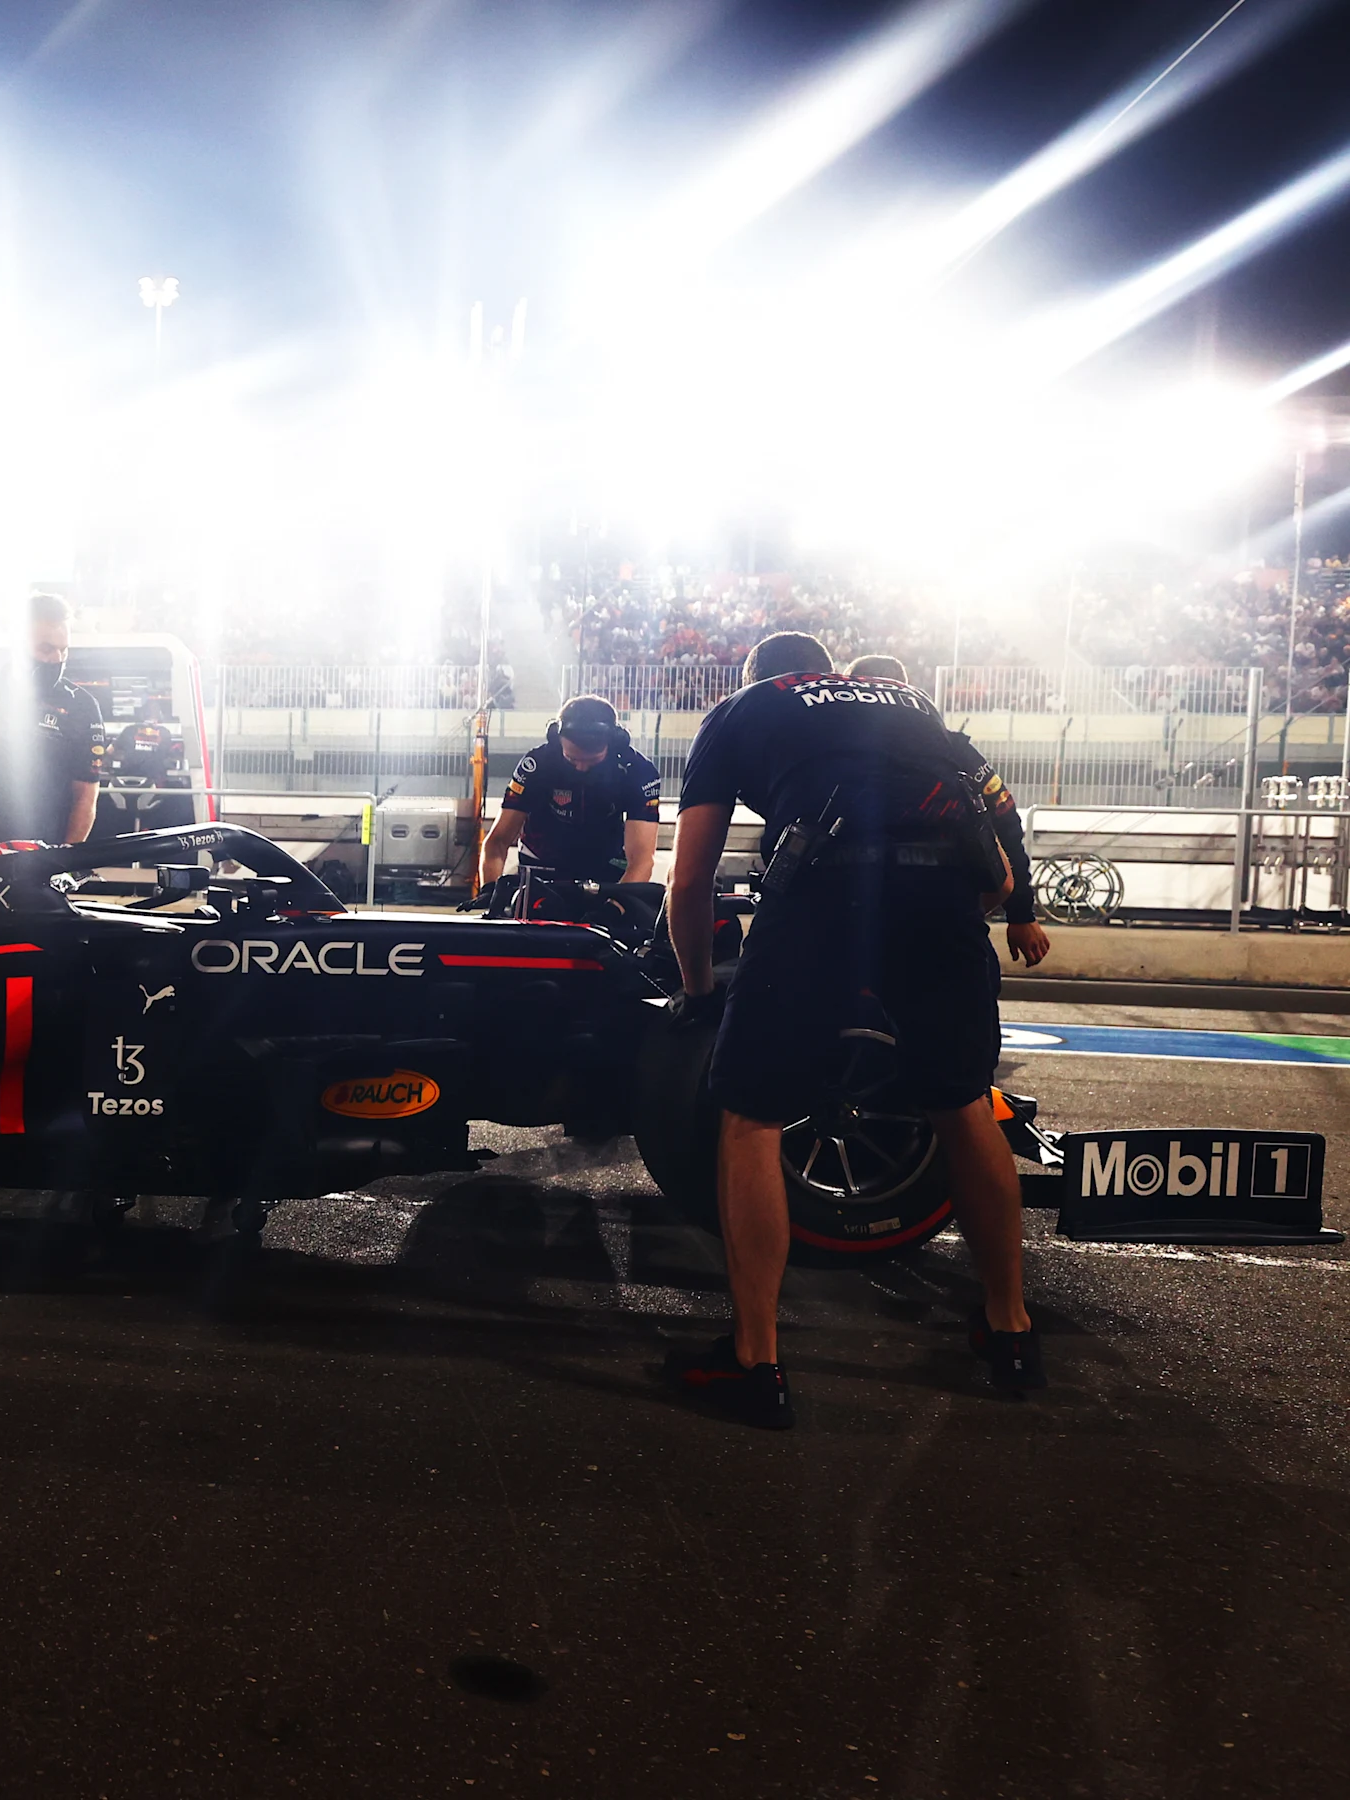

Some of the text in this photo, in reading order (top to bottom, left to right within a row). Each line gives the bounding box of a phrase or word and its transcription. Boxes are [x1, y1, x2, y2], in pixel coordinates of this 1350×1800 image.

[801, 688, 897, 708] Mobil
[188, 834, 215, 846] Tezos
[190, 939, 426, 977] ORACLE
[86, 1091, 165, 1116] Tezos
[349, 1082, 423, 1104] RAUCH
[1080, 1140, 1291, 1197] Mobil 1
